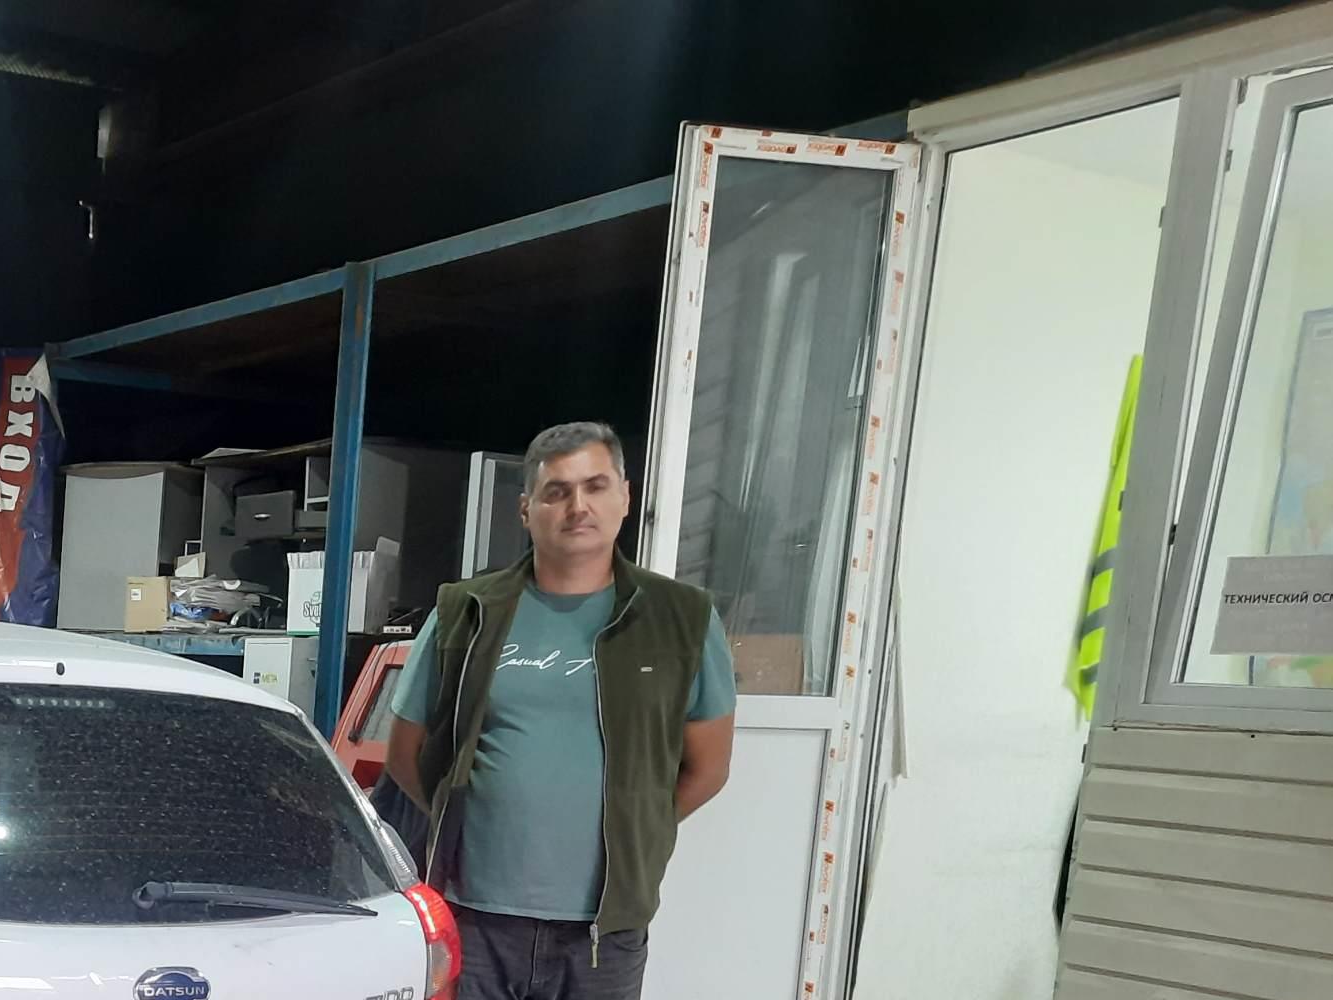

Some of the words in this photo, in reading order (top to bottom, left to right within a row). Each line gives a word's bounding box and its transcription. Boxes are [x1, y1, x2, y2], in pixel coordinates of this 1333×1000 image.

[1224, 591, 1309, 605] ТЕХНИЧЕСКИЙ
[496, 643, 561, 670] Casual
[144, 986, 205, 998] DATSUN
